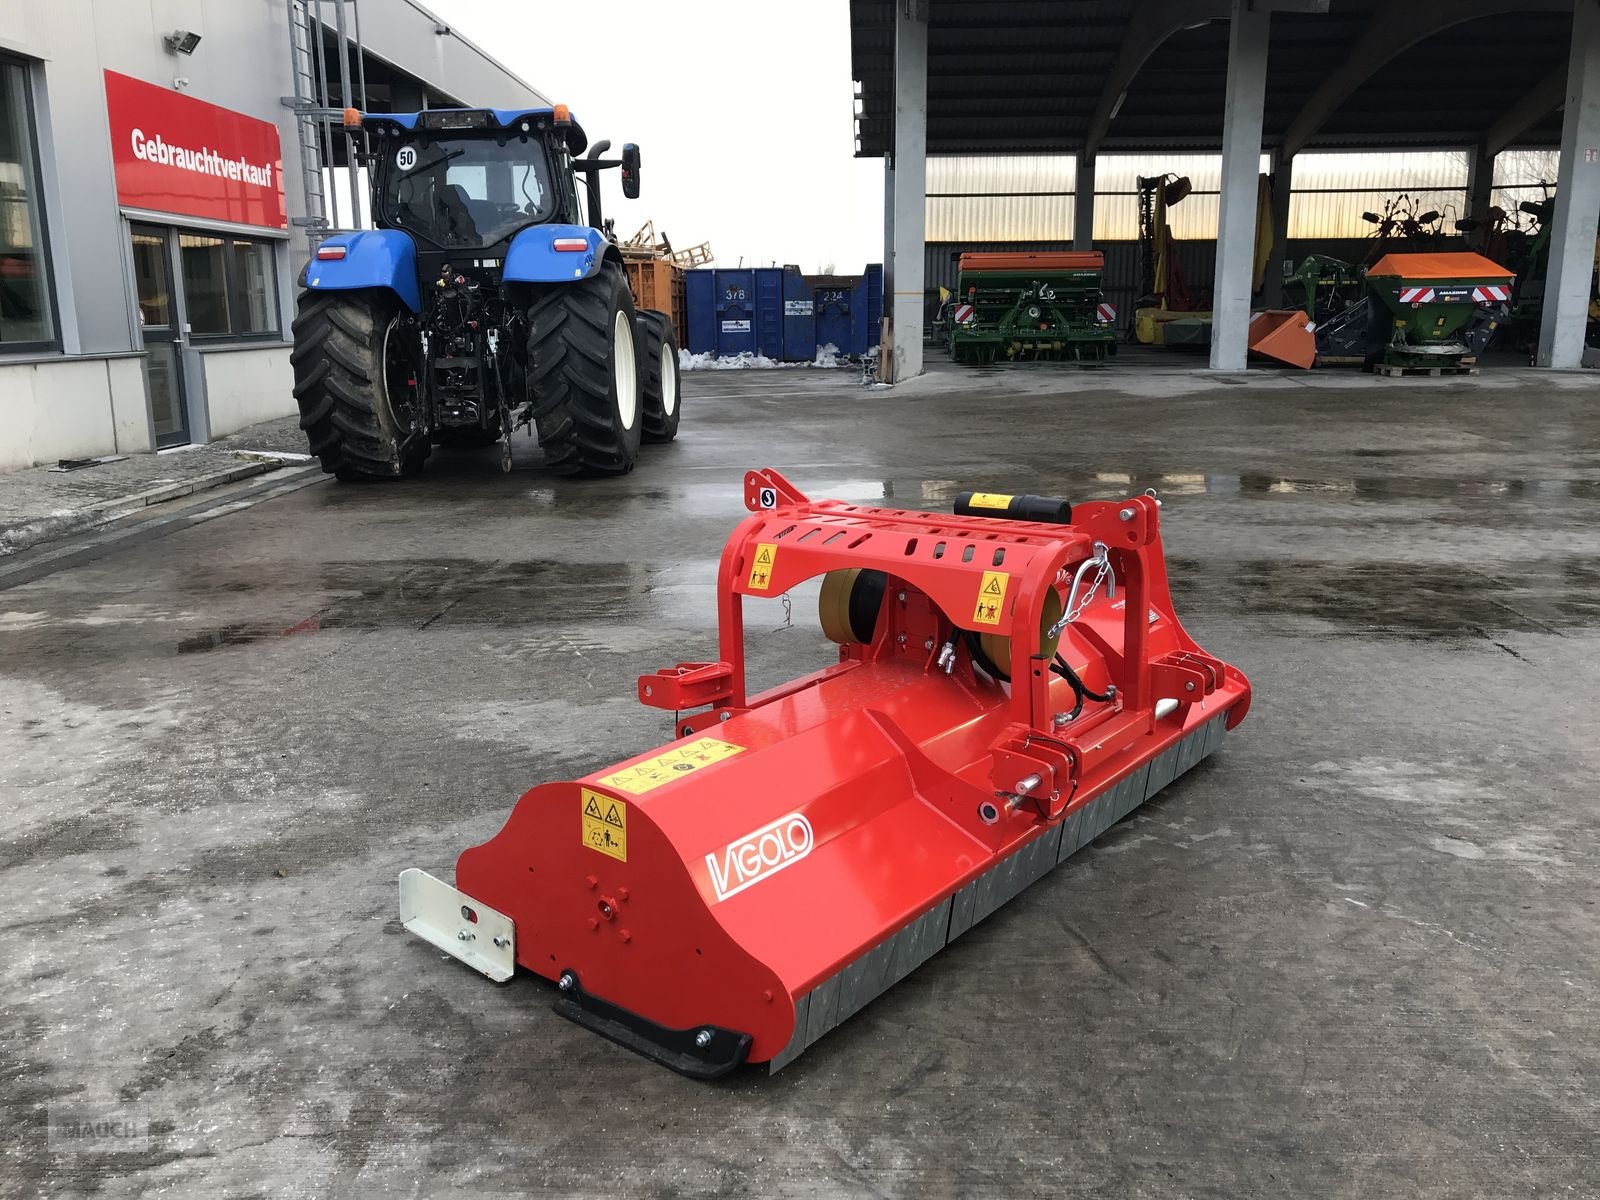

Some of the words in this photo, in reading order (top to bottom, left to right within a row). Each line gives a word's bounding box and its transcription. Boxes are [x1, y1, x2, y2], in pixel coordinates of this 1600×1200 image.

[131, 128, 272, 187] Gebrauchtverkauf
[400, 150, 413, 165] 50
[726, 290, 745, 300] 378
[823, 291, 843, 301] 224
[705, 816, 813, 900] VIGOLO
